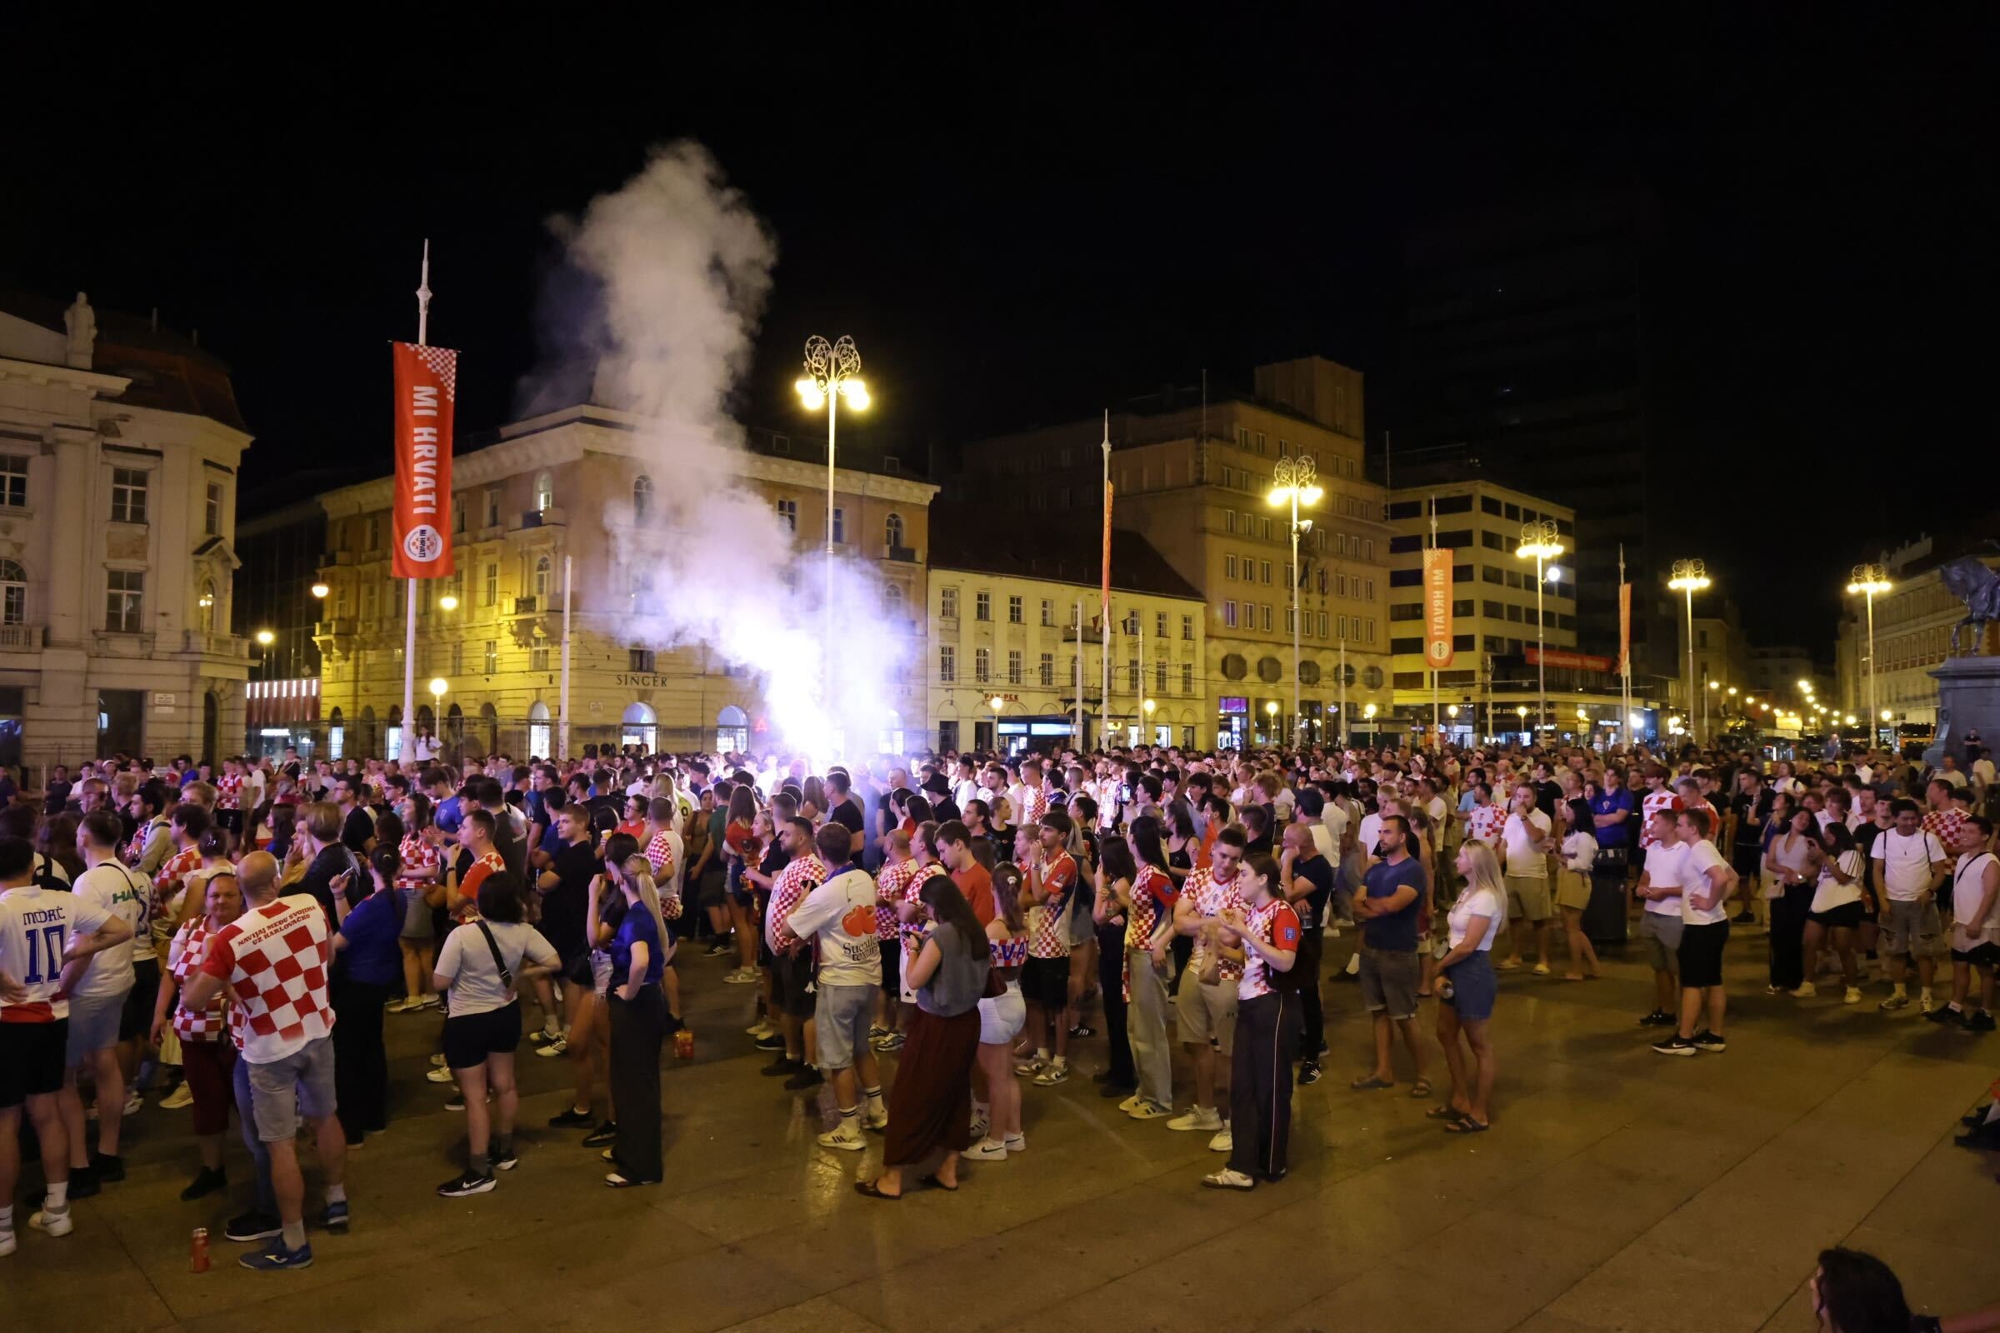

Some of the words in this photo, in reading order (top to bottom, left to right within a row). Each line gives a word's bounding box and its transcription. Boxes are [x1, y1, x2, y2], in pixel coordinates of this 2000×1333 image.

[413, 386, 438, 416] MI
[413, 427, 438, 514] HRVATI
[616, 674, 667, 687] SINGER
[23, 906, 66, 925] MODRĆ
[238, 928, 266, 946] NAVIJAJ
[24, 924, 66, 985] 10
